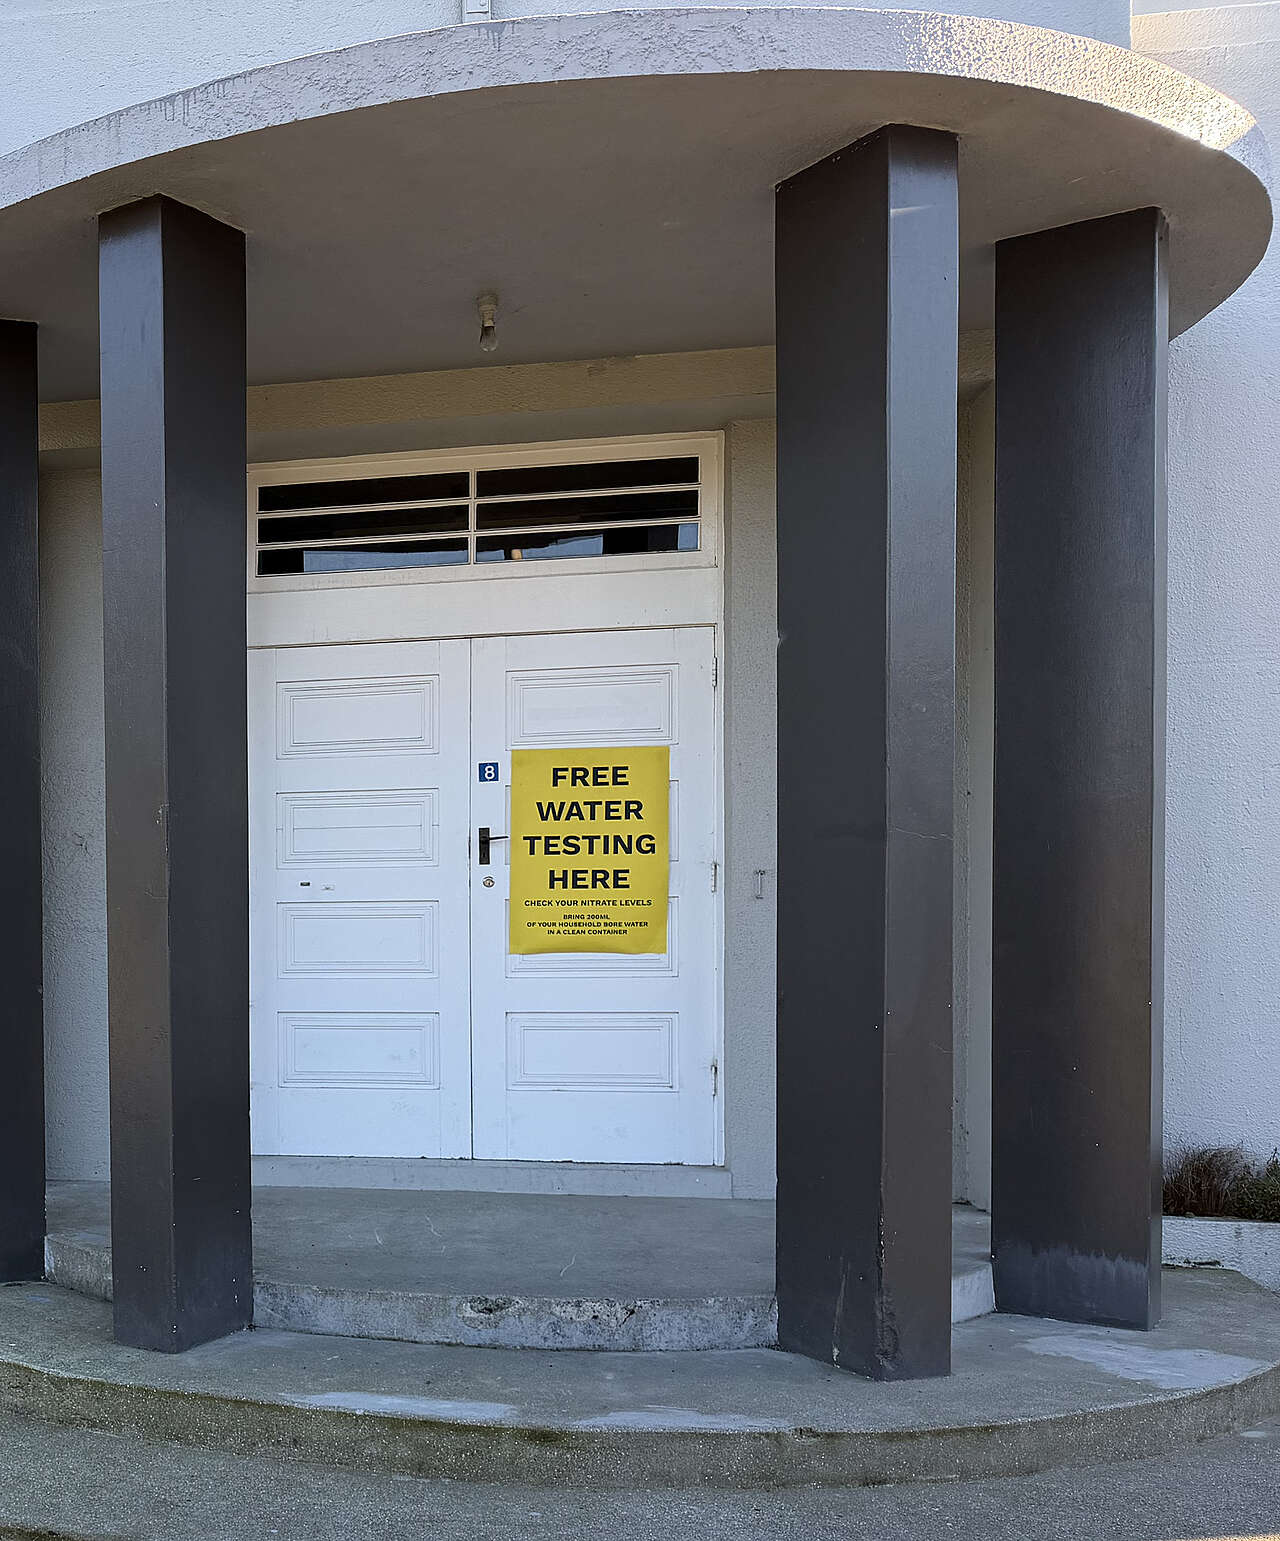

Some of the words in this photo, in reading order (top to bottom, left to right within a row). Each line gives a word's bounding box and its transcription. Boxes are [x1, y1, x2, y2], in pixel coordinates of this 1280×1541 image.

[484, 765, 496, 780] 8
[552, 766, 630, 788] FREE
[536, 800, 644, 822] WATER
[523, 834, 656, 856] TESTING
[548, 869, 630, 890] HERE
